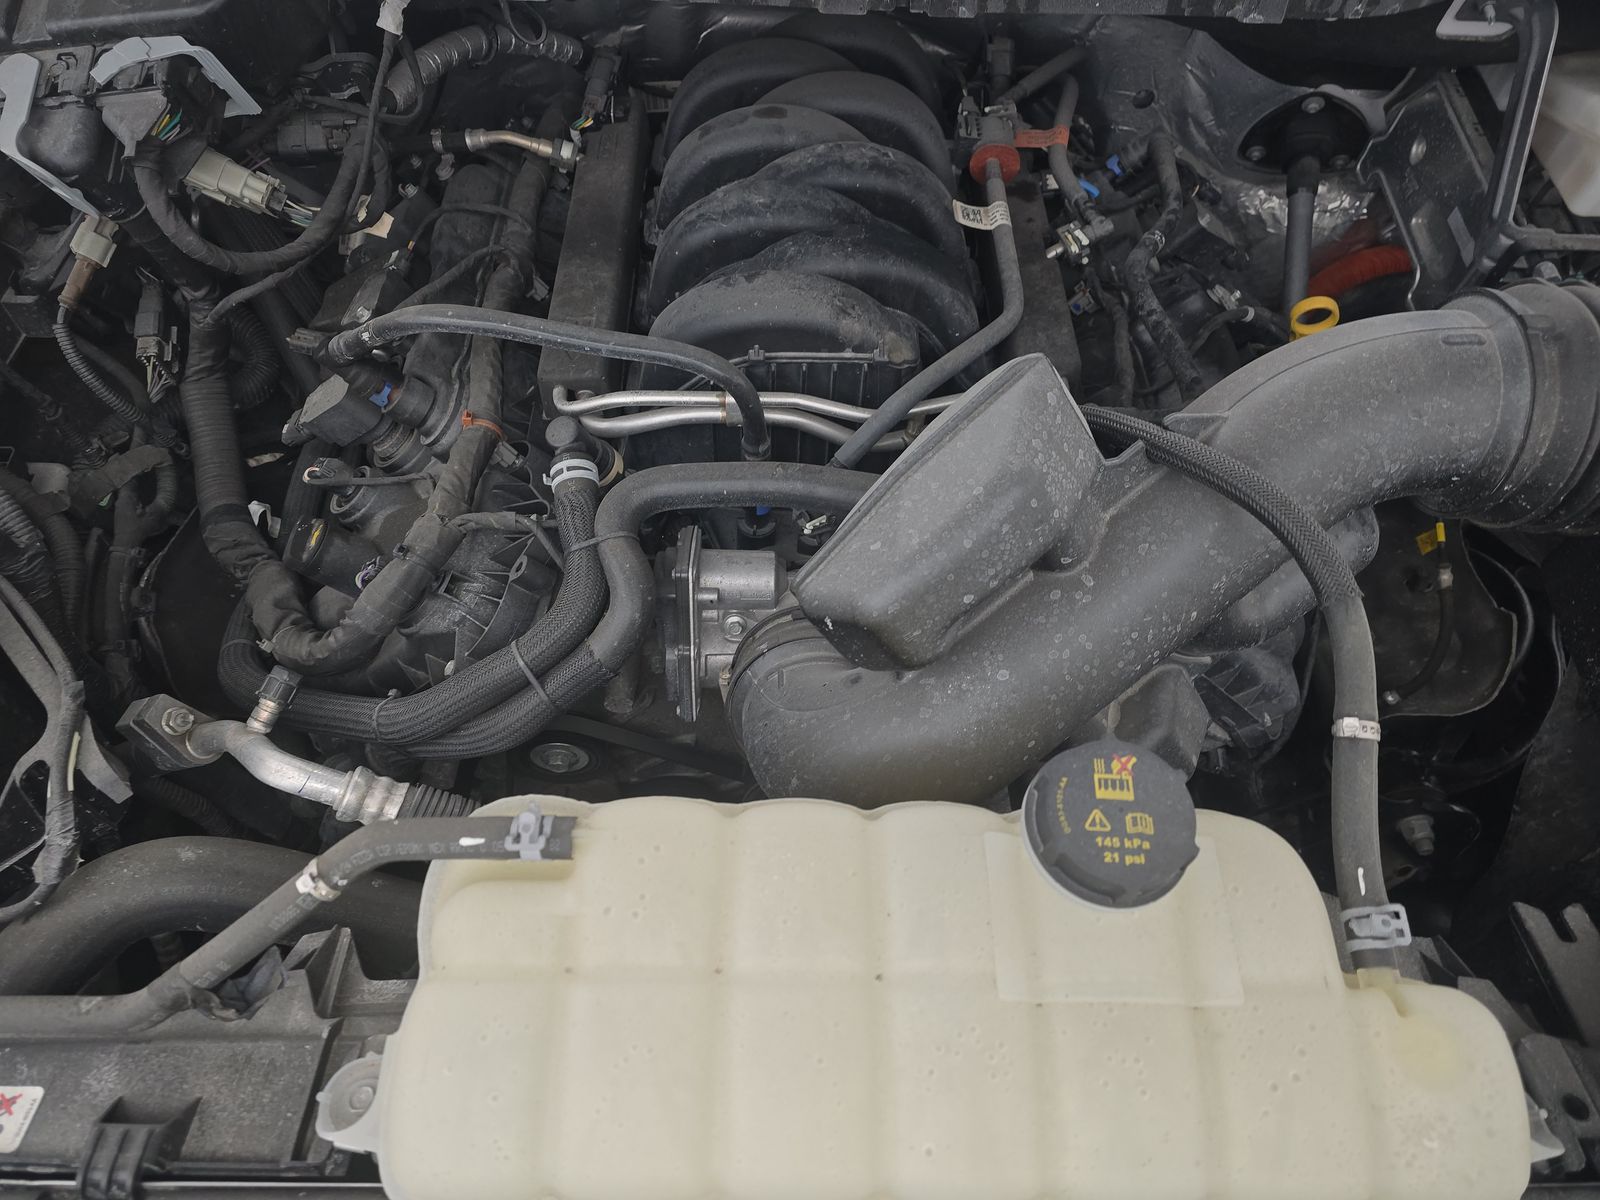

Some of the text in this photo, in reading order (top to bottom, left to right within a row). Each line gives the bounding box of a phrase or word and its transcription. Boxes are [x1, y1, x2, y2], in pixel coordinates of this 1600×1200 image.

[1124, 837, 1150, 850] kPa
[1103, 851, 1145, 867] 21 psi
